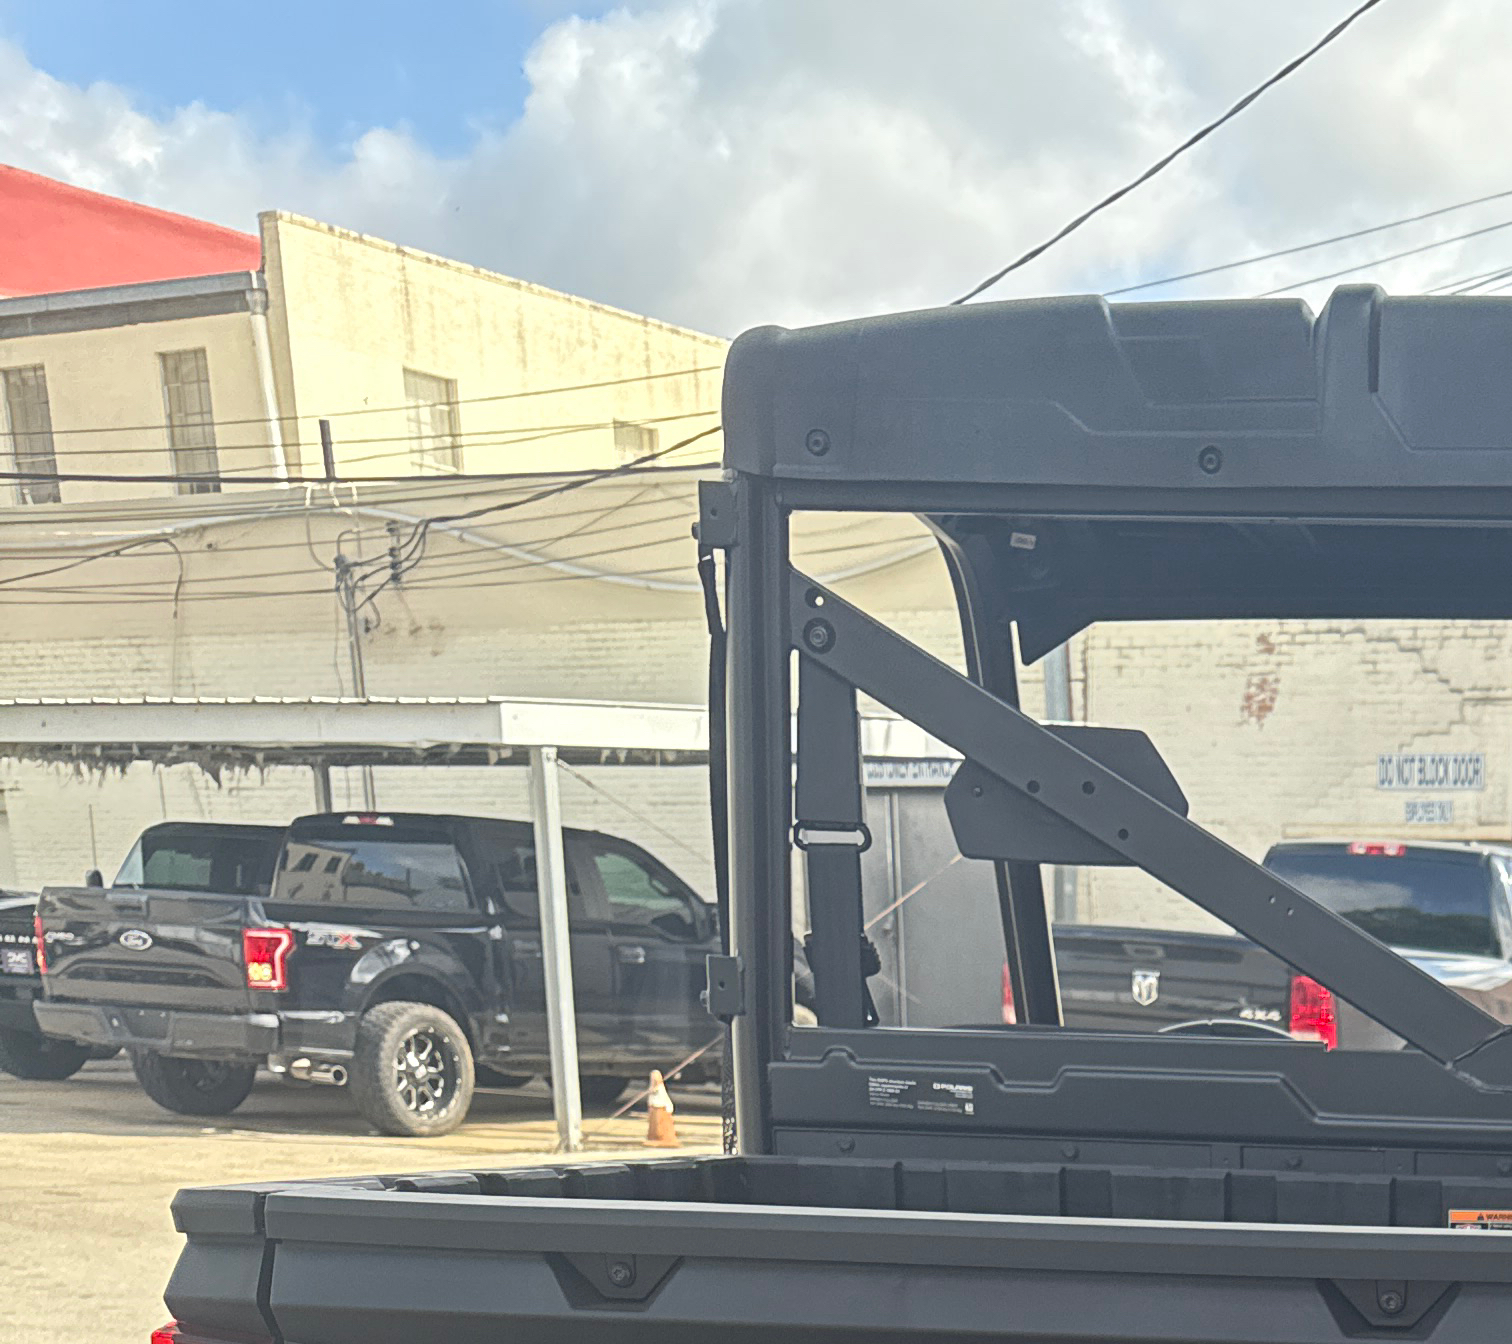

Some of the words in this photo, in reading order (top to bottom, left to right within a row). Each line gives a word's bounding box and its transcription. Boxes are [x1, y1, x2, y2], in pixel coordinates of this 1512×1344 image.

[1379, 757, 1394, 786] DO
[1396, 757, 1415, 786] NOT
[1417, 757, 1449, 786] BLOCK
[1451, 757, 1483, 786] DOOR
